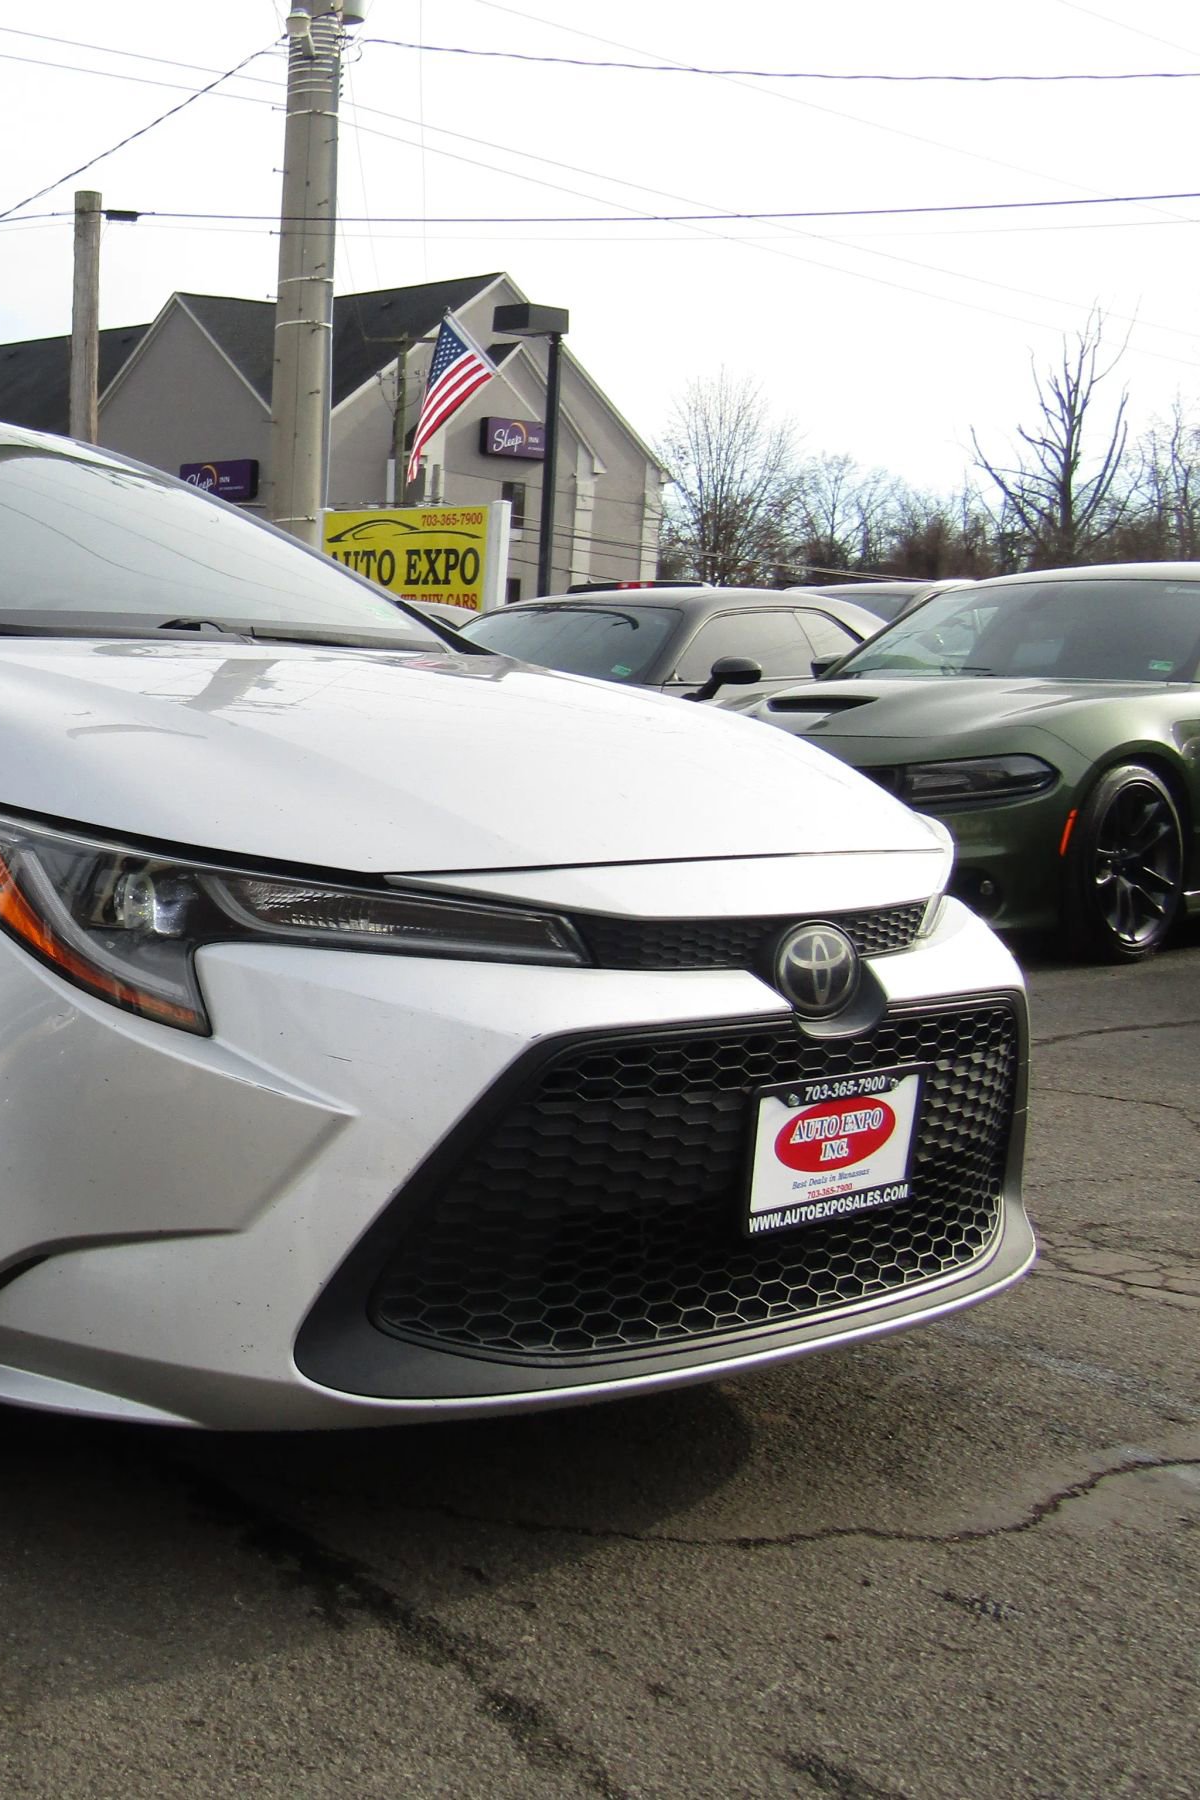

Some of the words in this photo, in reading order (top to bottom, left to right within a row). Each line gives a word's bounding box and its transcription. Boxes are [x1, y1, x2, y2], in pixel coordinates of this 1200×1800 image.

[493, 430, 522, 453] Sleep
[421, 512, 483, 527] 703-365-7900
[404, 547, 480, 586] EXPO
[805, 1075, 885, 1101] 703-365-7900
[790, 1115, 840, 1144] AUTO
[841, 1108, 884, 1134] EXPO
[820, 1138, 849, 1161] INC.
[792, 1180, 807, 1190] Best
[809, 1176, 828, 1187] Deals
[829, 1174, 837, 1182] in
[808, 1183, 853, 1199] 703-365-7900
[749, 1183, 908, 1233] WWW.AUTOEXPOSALES.COM
